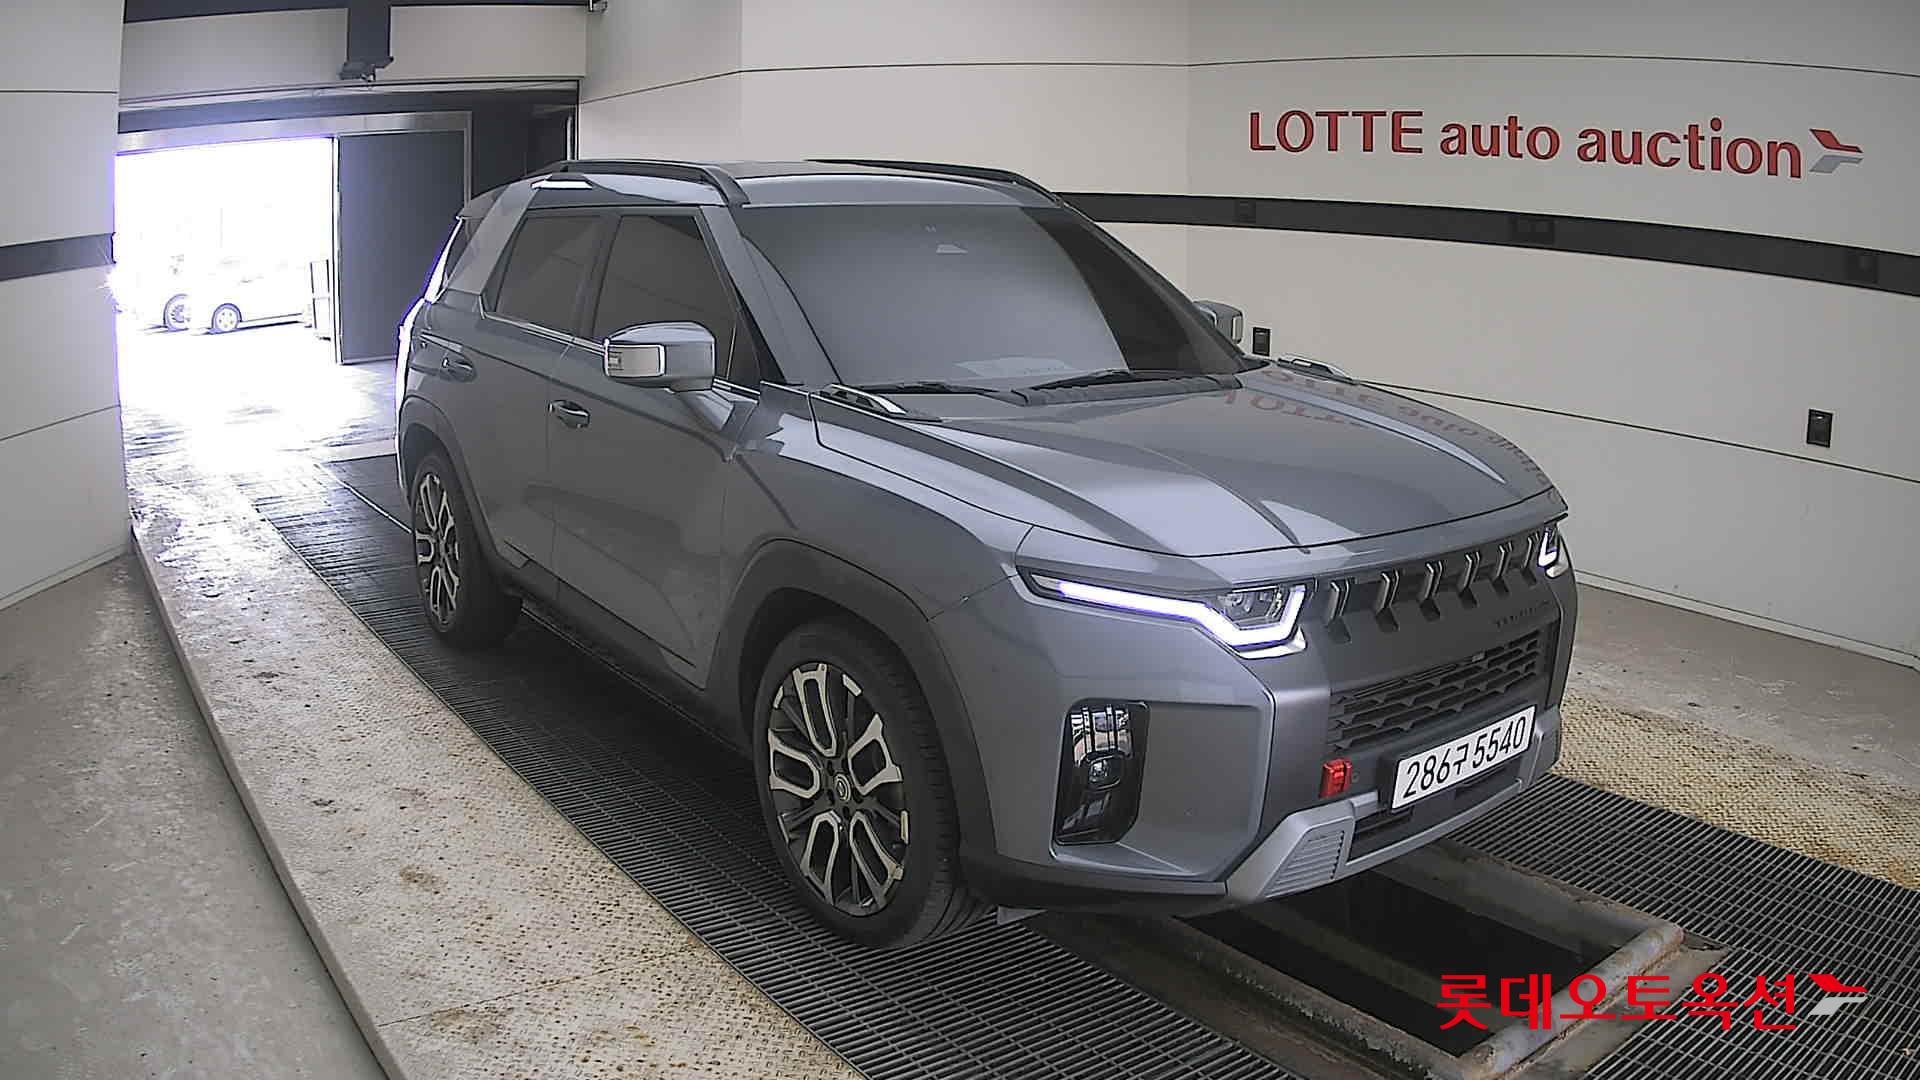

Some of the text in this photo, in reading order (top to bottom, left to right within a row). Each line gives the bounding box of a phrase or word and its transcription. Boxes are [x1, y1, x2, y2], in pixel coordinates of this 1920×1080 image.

[1249, 111, 1802, 178] LOTTE auto auction
